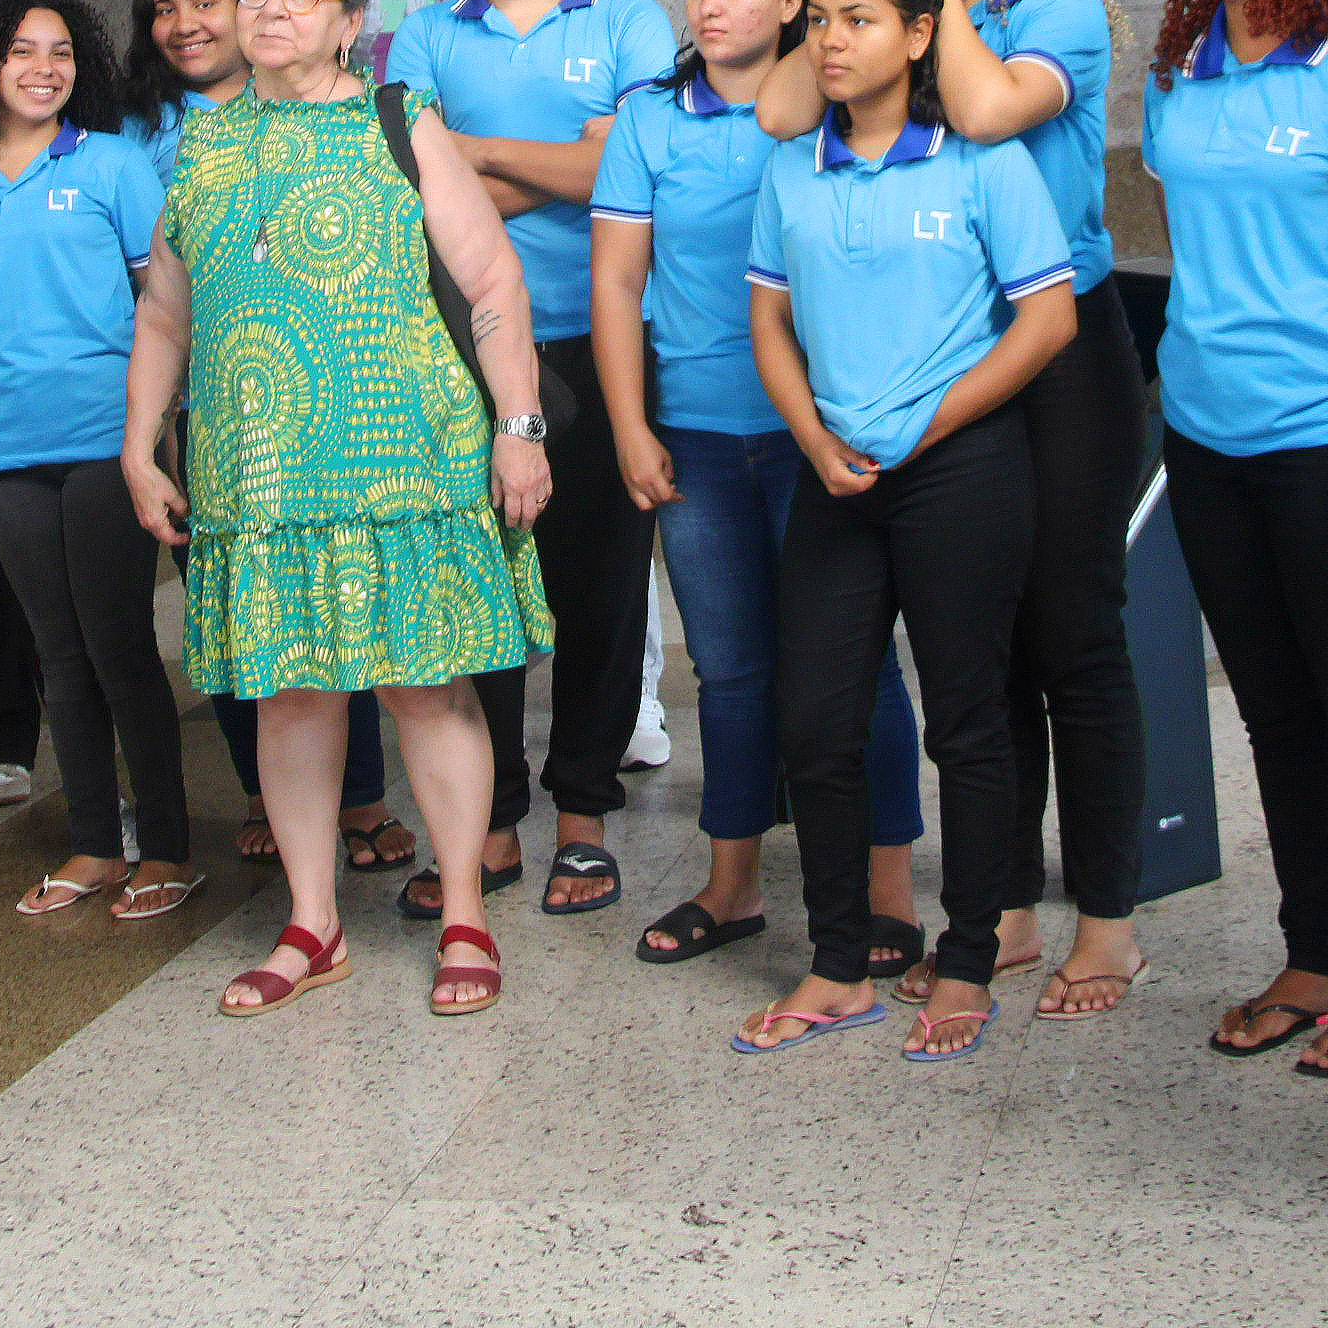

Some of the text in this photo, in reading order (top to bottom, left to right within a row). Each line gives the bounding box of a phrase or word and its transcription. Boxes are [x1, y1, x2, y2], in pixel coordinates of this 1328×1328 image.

[563, 57, 597, 83] LT
[1264, 125, 1310, 156] LT
[48, 188, 80, 211] LT
[913, 210, 953, 241] LT
